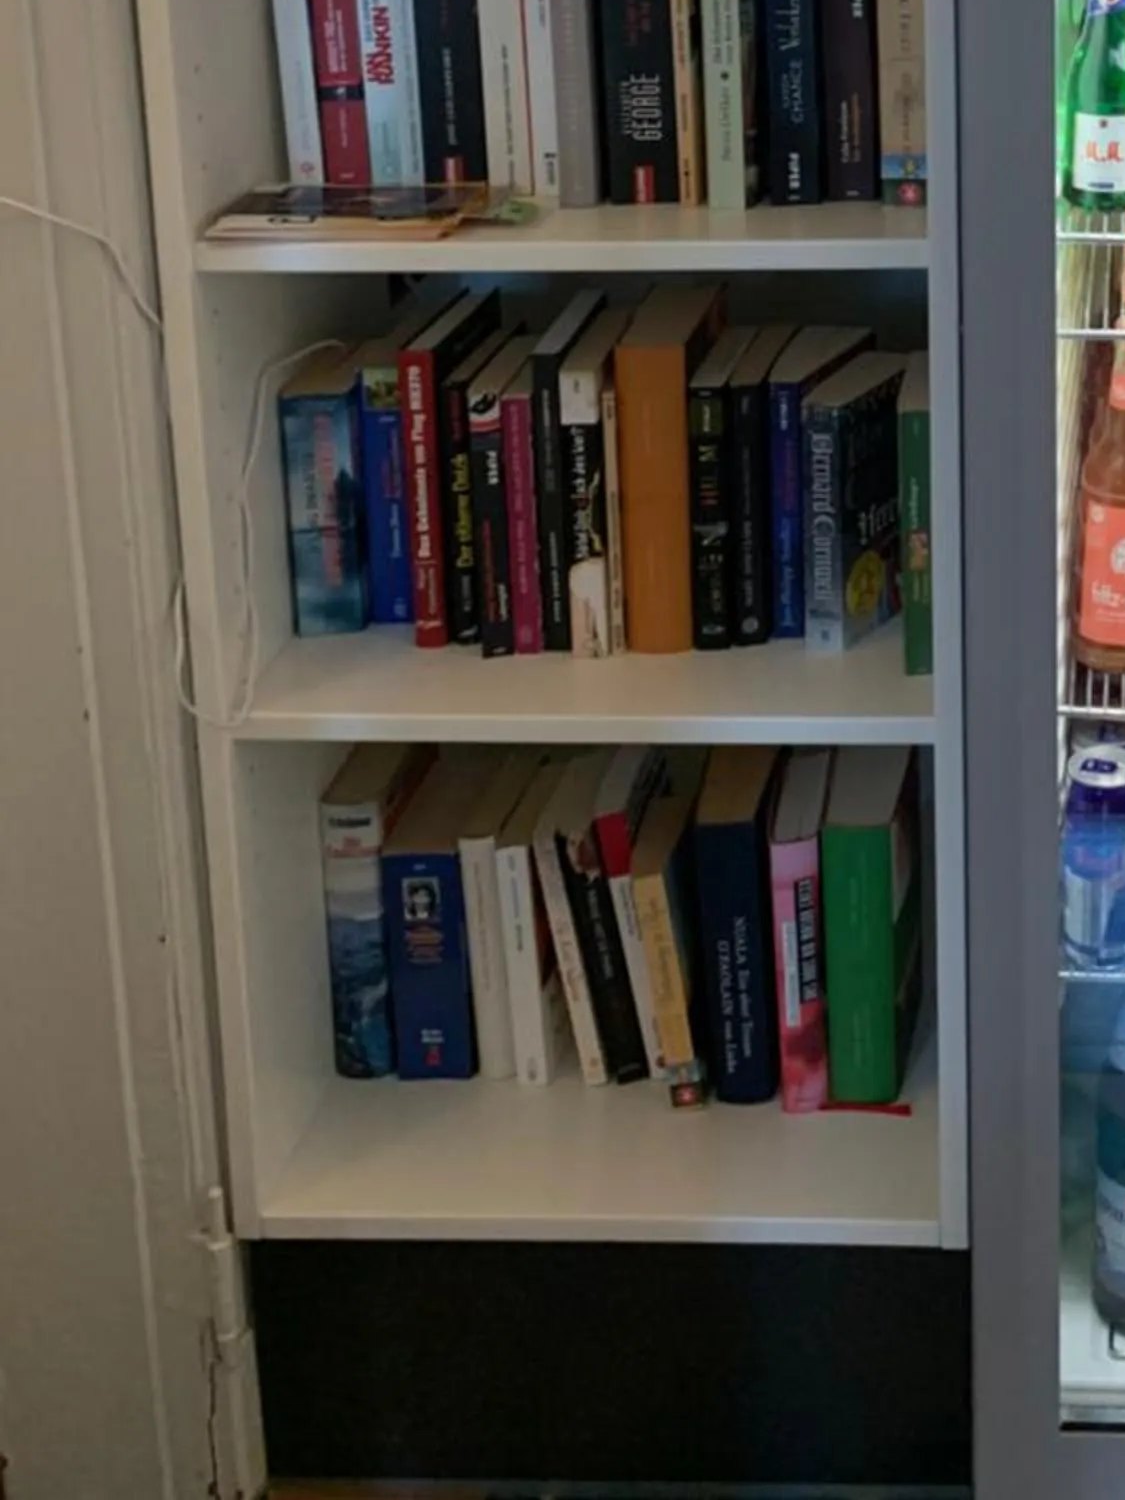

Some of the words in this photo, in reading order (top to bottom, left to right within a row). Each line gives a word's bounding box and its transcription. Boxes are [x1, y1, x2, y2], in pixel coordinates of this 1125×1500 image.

[373, 5, 395, 85] RANKIN
[632, 73, 663, 141] GEORGE
[787, 58, 804, 124] CHANCE
[410, 413, 427, 442] Flug
[811, 430, 836, 514] Bernard
[812, 515, 836, 601] Cornwell
